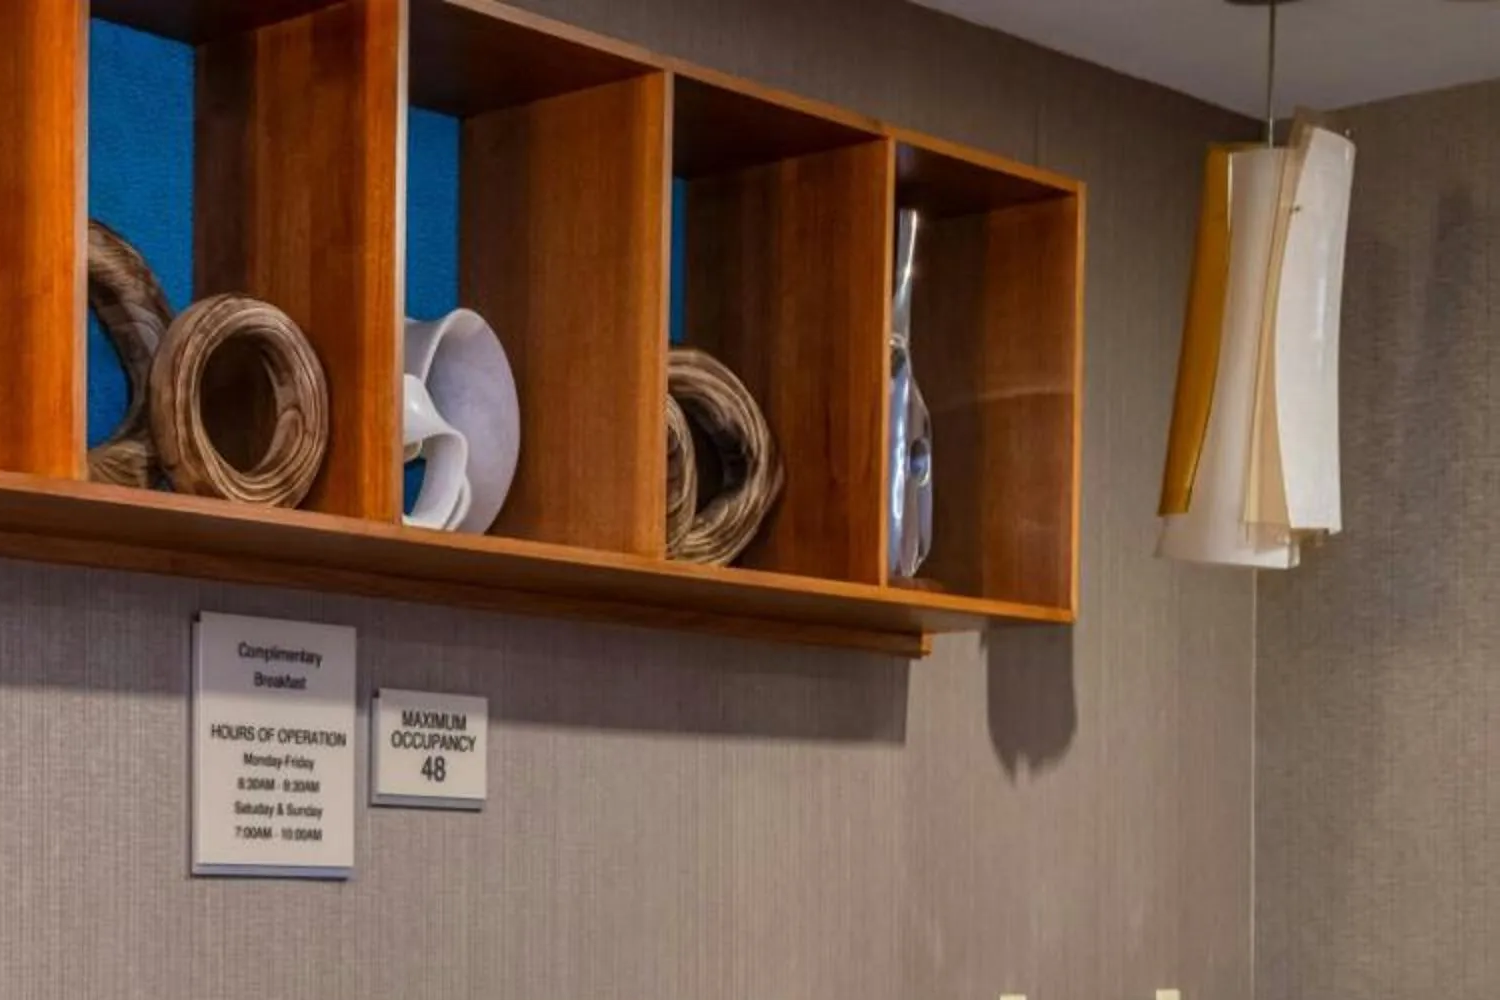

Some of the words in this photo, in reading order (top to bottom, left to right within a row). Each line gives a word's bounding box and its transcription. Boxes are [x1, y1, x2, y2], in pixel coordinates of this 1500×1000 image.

[238, 642, 323, 668] Complimentary
[253, 671, 307, 690] Breakfast
[402, 710, 467, 731] MAXIMUM
[211, 723, 255, 742] HOURS
[258, 727, 275, 742] OF
[278, 728, 347, 748] OPERATION
[391, 729, 477, 752] OCCUPANCY
[421, 755, 446, 782] 48
[277, 802, 284, 816] &
[286, 802, 323, 820] Sunday
